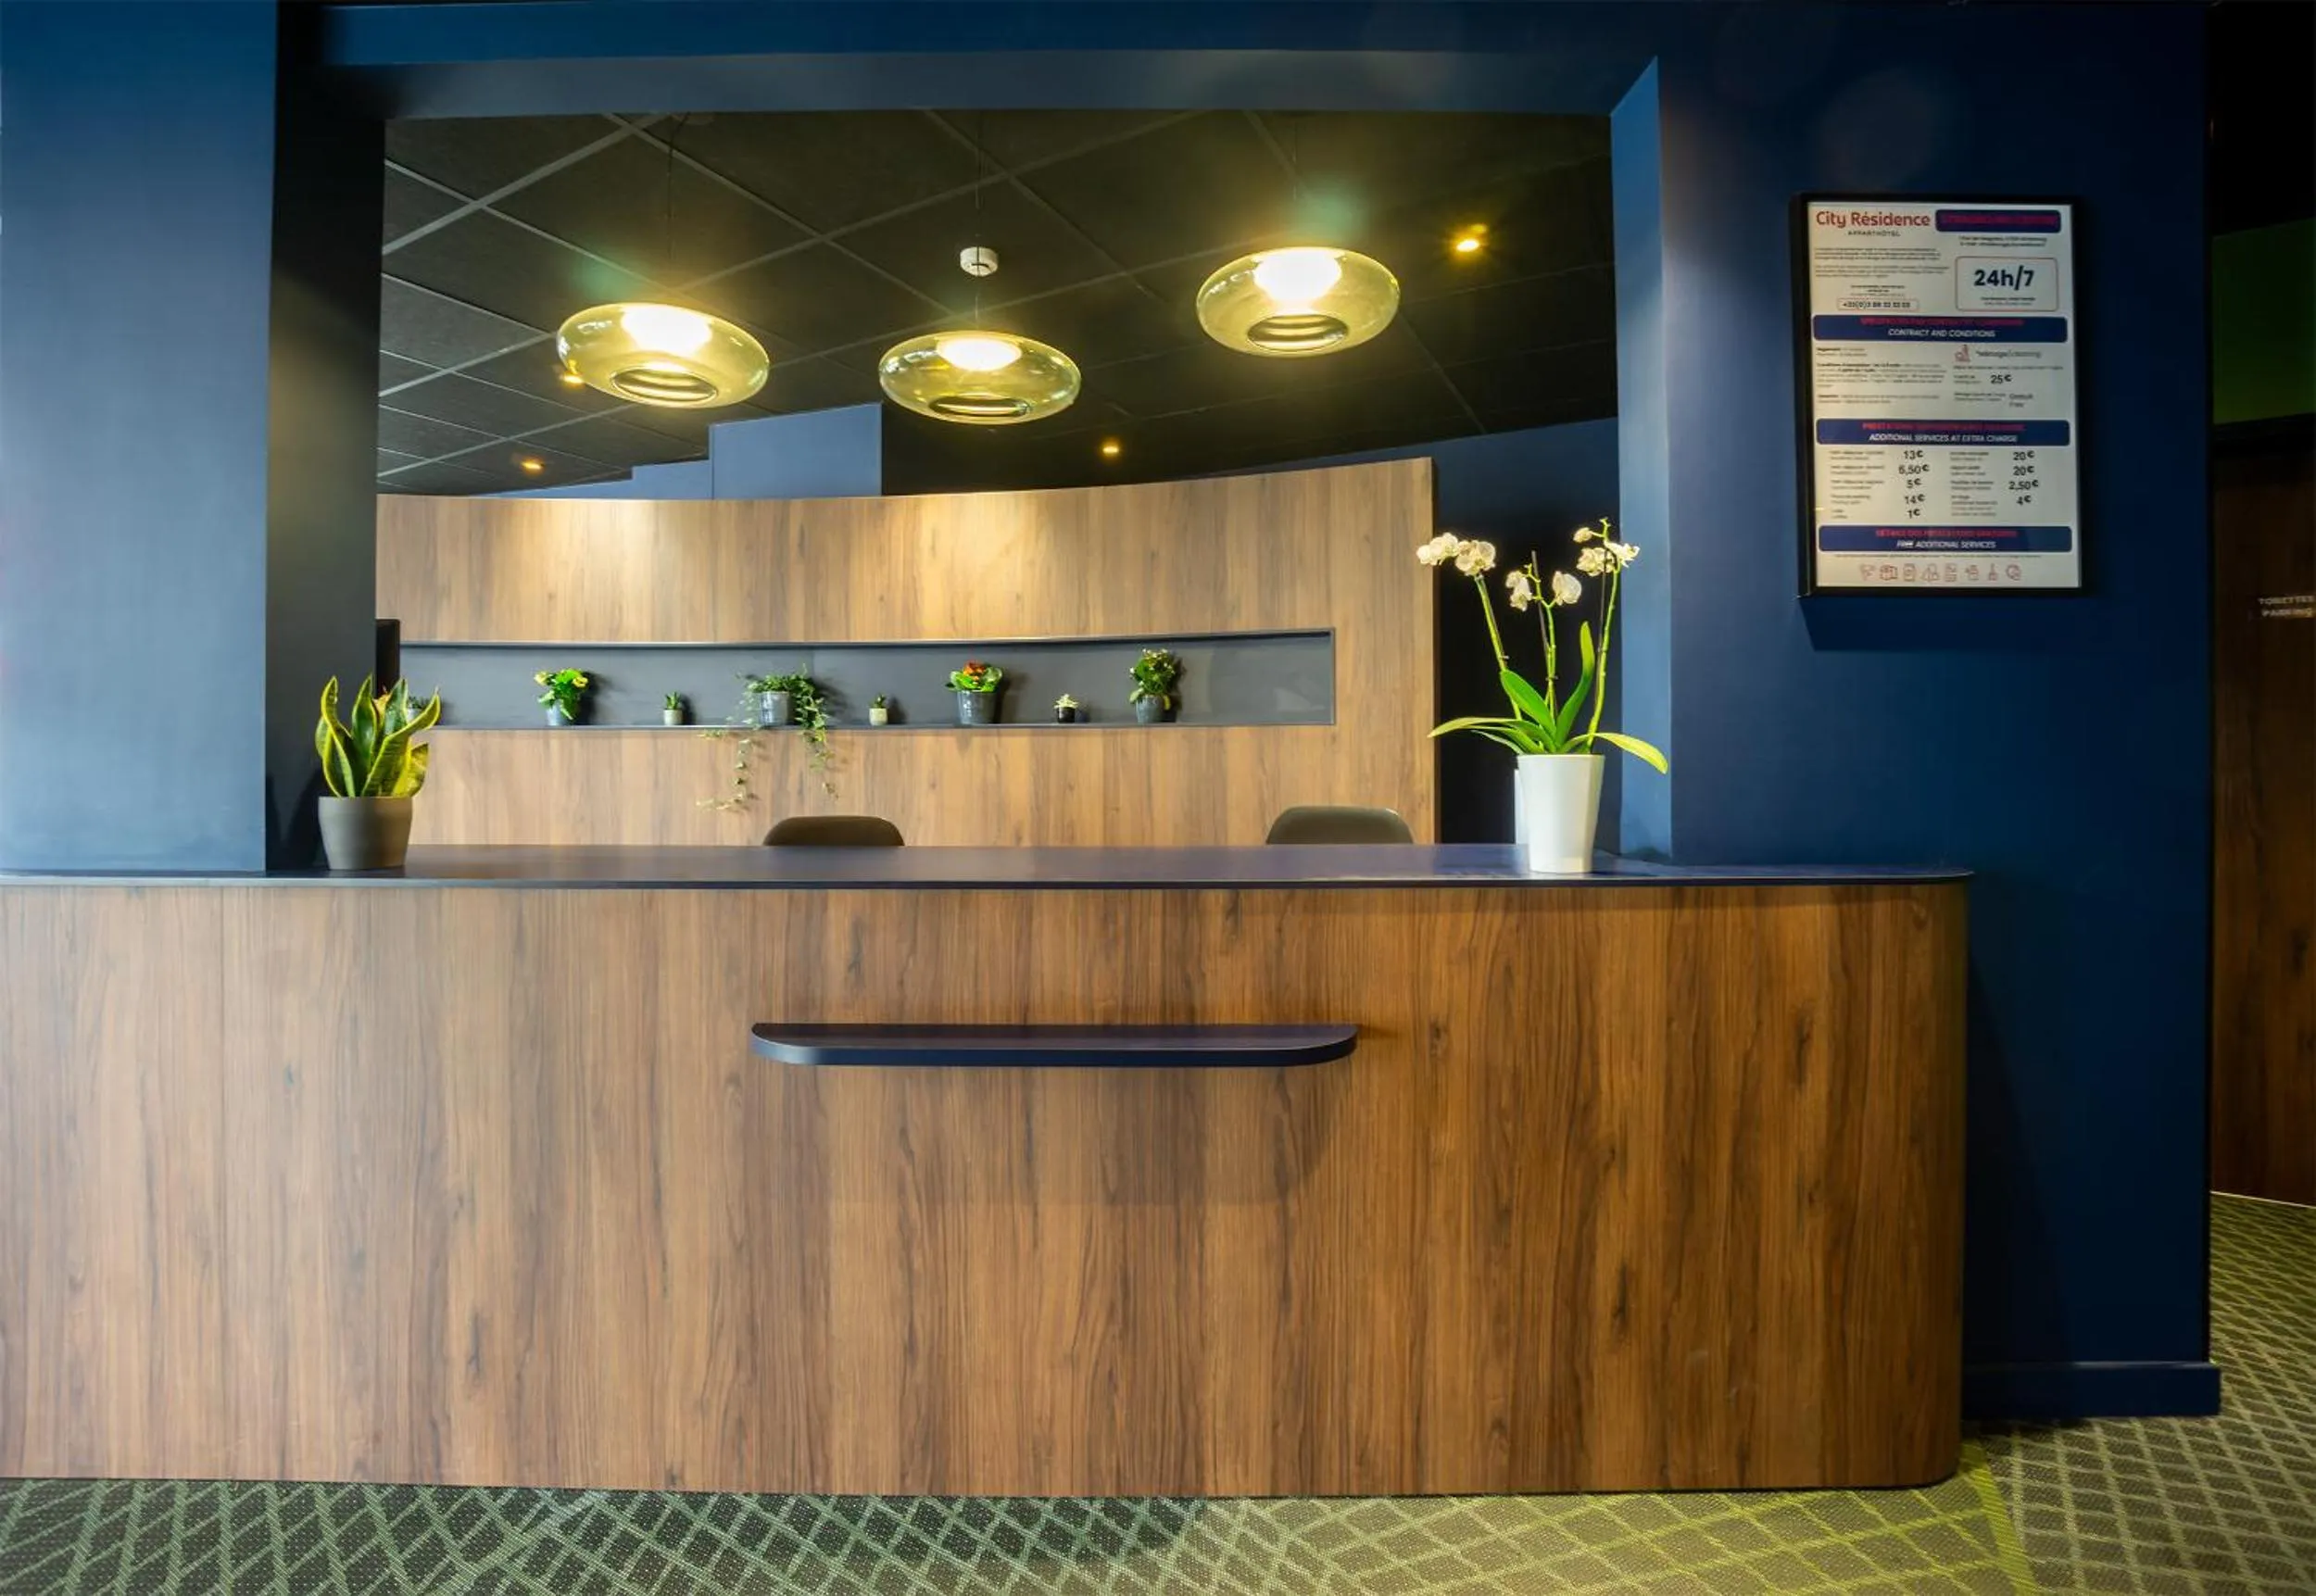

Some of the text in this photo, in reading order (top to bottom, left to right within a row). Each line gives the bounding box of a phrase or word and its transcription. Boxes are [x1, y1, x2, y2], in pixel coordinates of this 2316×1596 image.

[1816, 211, 1845, 229] City
[1851, 211, 1931, 226] Résidence
[1973, 265, 2035, 291] 24h/7
[1888, 328, 1996, 338] CONTRACT AND CONDITIONS
[1990, 374, 2012, 384] 25€
[1869, 433, 1913, 441] ADDITIONAL
[1914, 434, 1949, 442] SERVICES
[1986, 434, 2019, 443] CHARGE
[1903, 450, 1924, 460] 13€
[2012, 450, 2035, 461] 20€
[2012, 465, 2035, 476] 20€
[1914, 540, 1958, 548] ADDITIONAL
